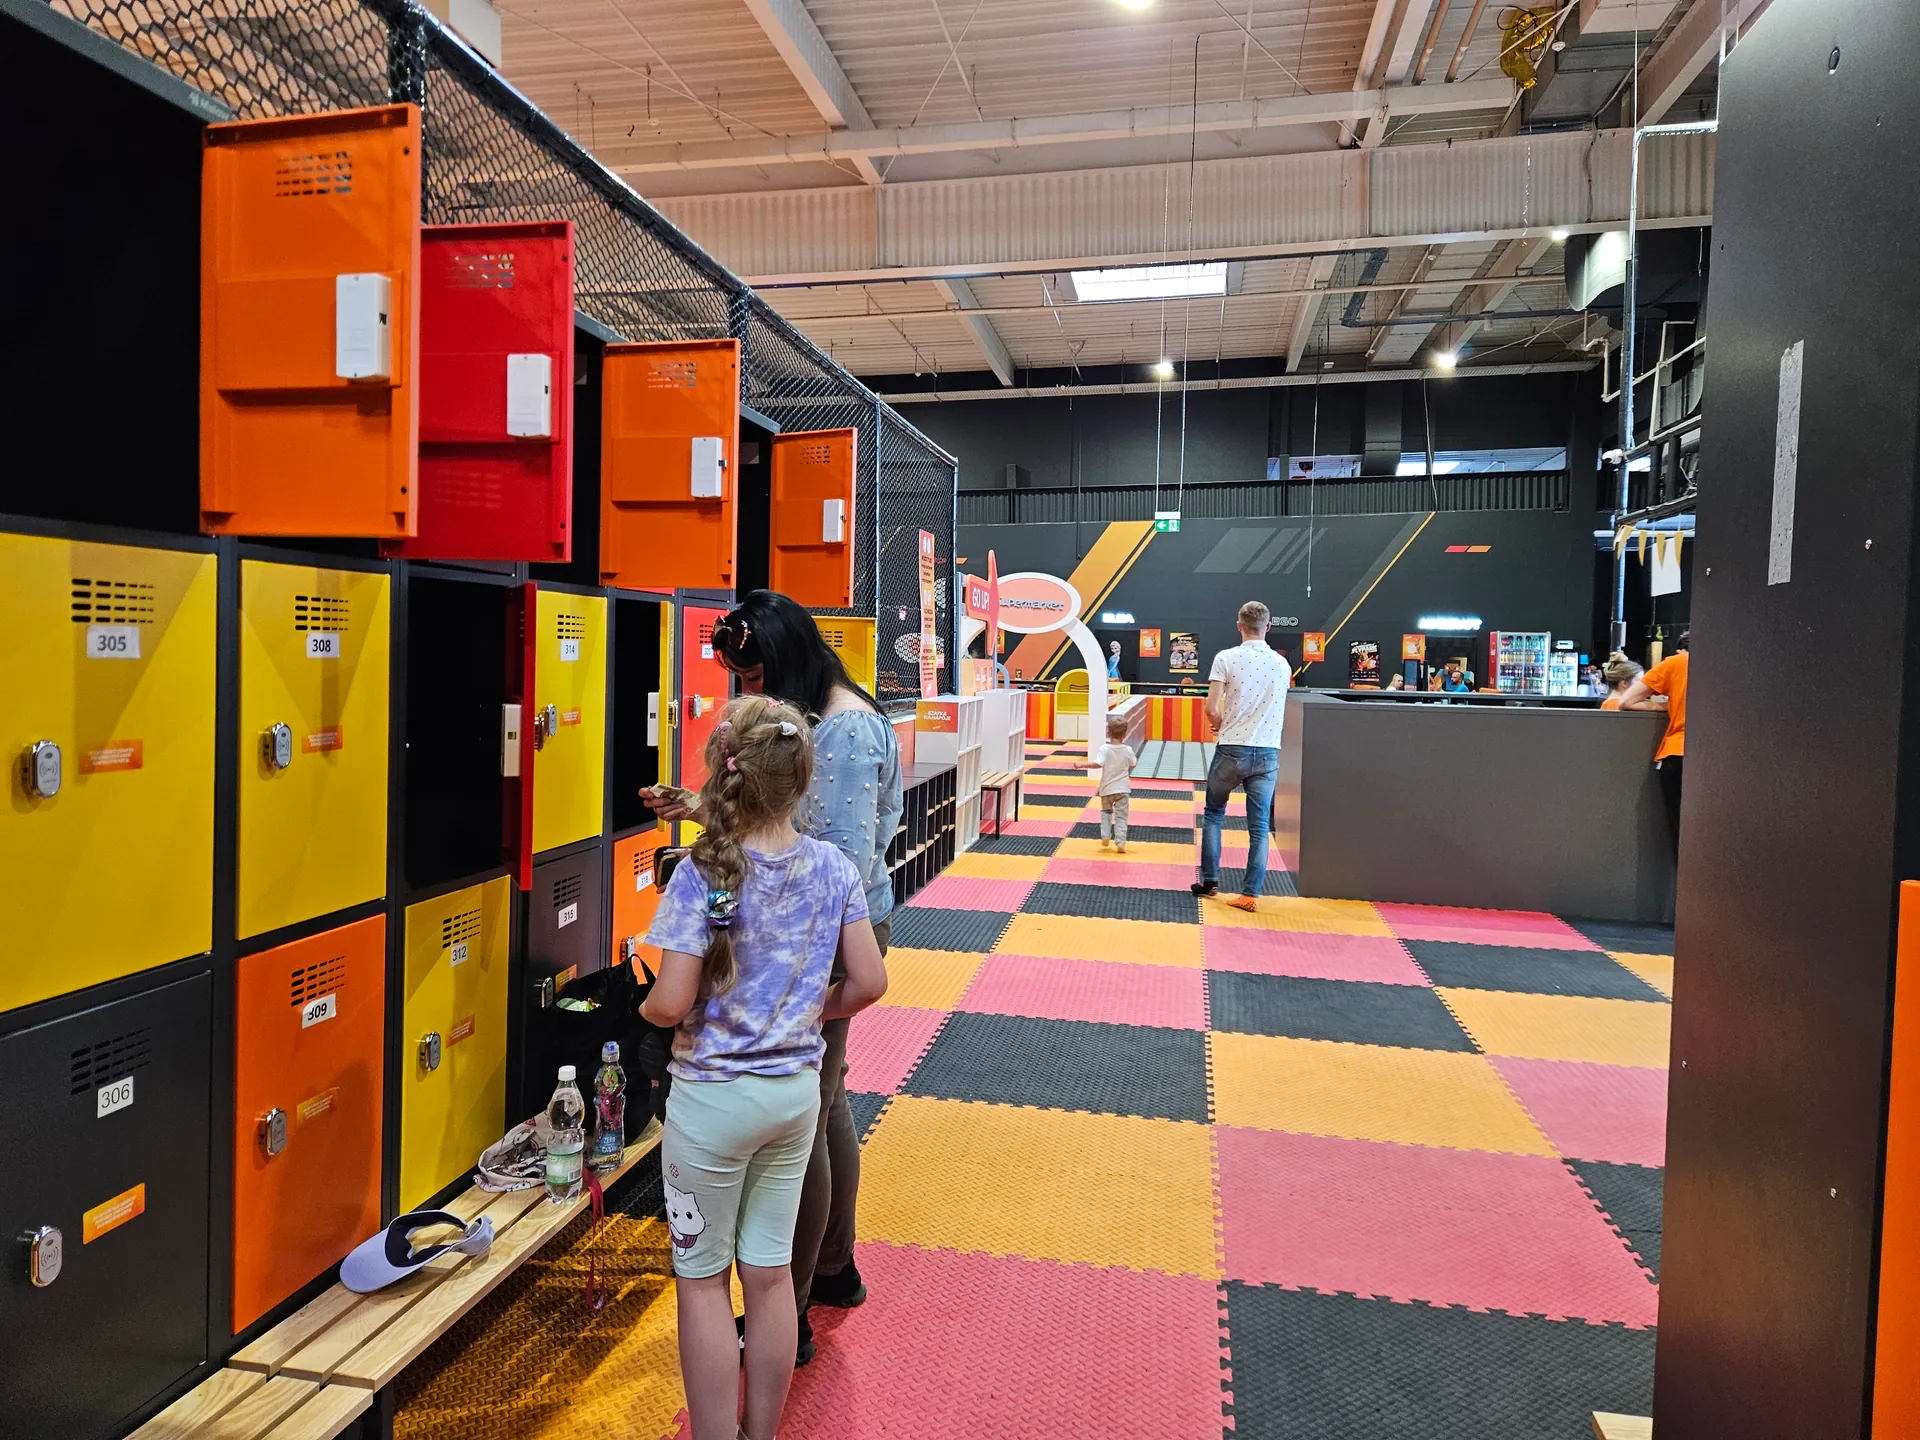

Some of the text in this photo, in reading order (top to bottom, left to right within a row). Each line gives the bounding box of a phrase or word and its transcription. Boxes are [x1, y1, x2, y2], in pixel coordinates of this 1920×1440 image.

[972, 587, 990, 611] GO UP!
[1000, 597, 1064, 611] upermarket
[1270, 616, 1299, 626] EGO
[97, 634, 127, 652] 305
[312, 639, 331, 652] 308
[565, 644, 575, 654] 314
[563, 908, 574, 922] 315
[452, 945, 467, 961] 312
[308, 1002, 328, 1021] 309
[101, 1083, 130, 1109] 306
